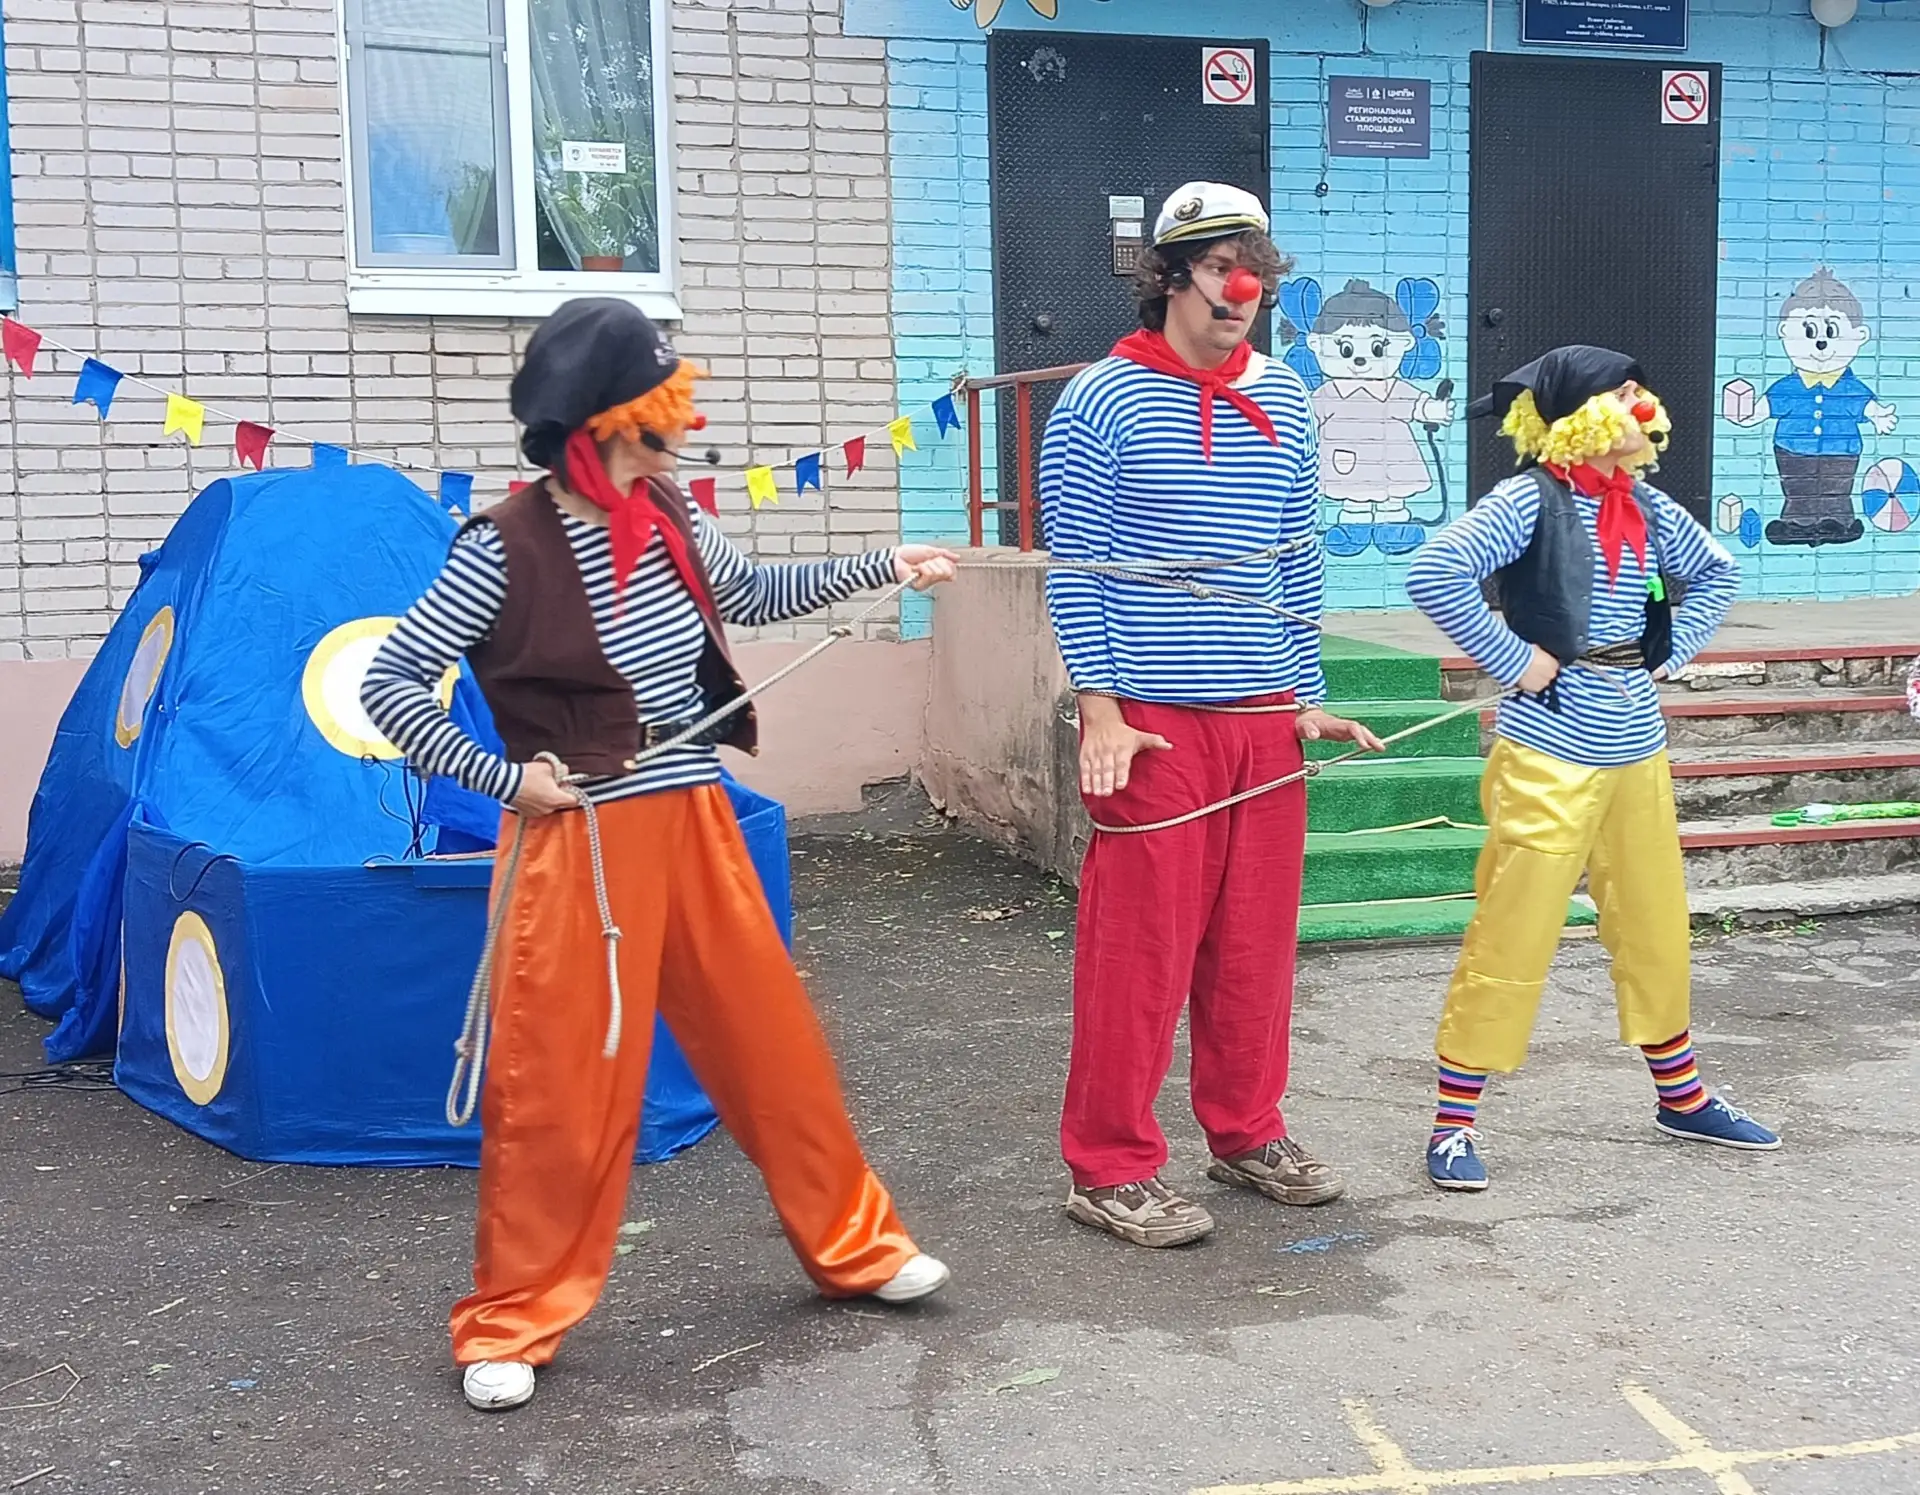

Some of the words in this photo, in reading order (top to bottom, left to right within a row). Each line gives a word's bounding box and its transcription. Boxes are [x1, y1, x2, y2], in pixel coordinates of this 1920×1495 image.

[1348, 106, 1412, 115] РЕГИОНАЛЬНАЯ
[1344, 115, 1416, 125] СТАЖИРОВОЧНАЯ
[1356, 124, 1404, 133] ПЛОЩАДКА
